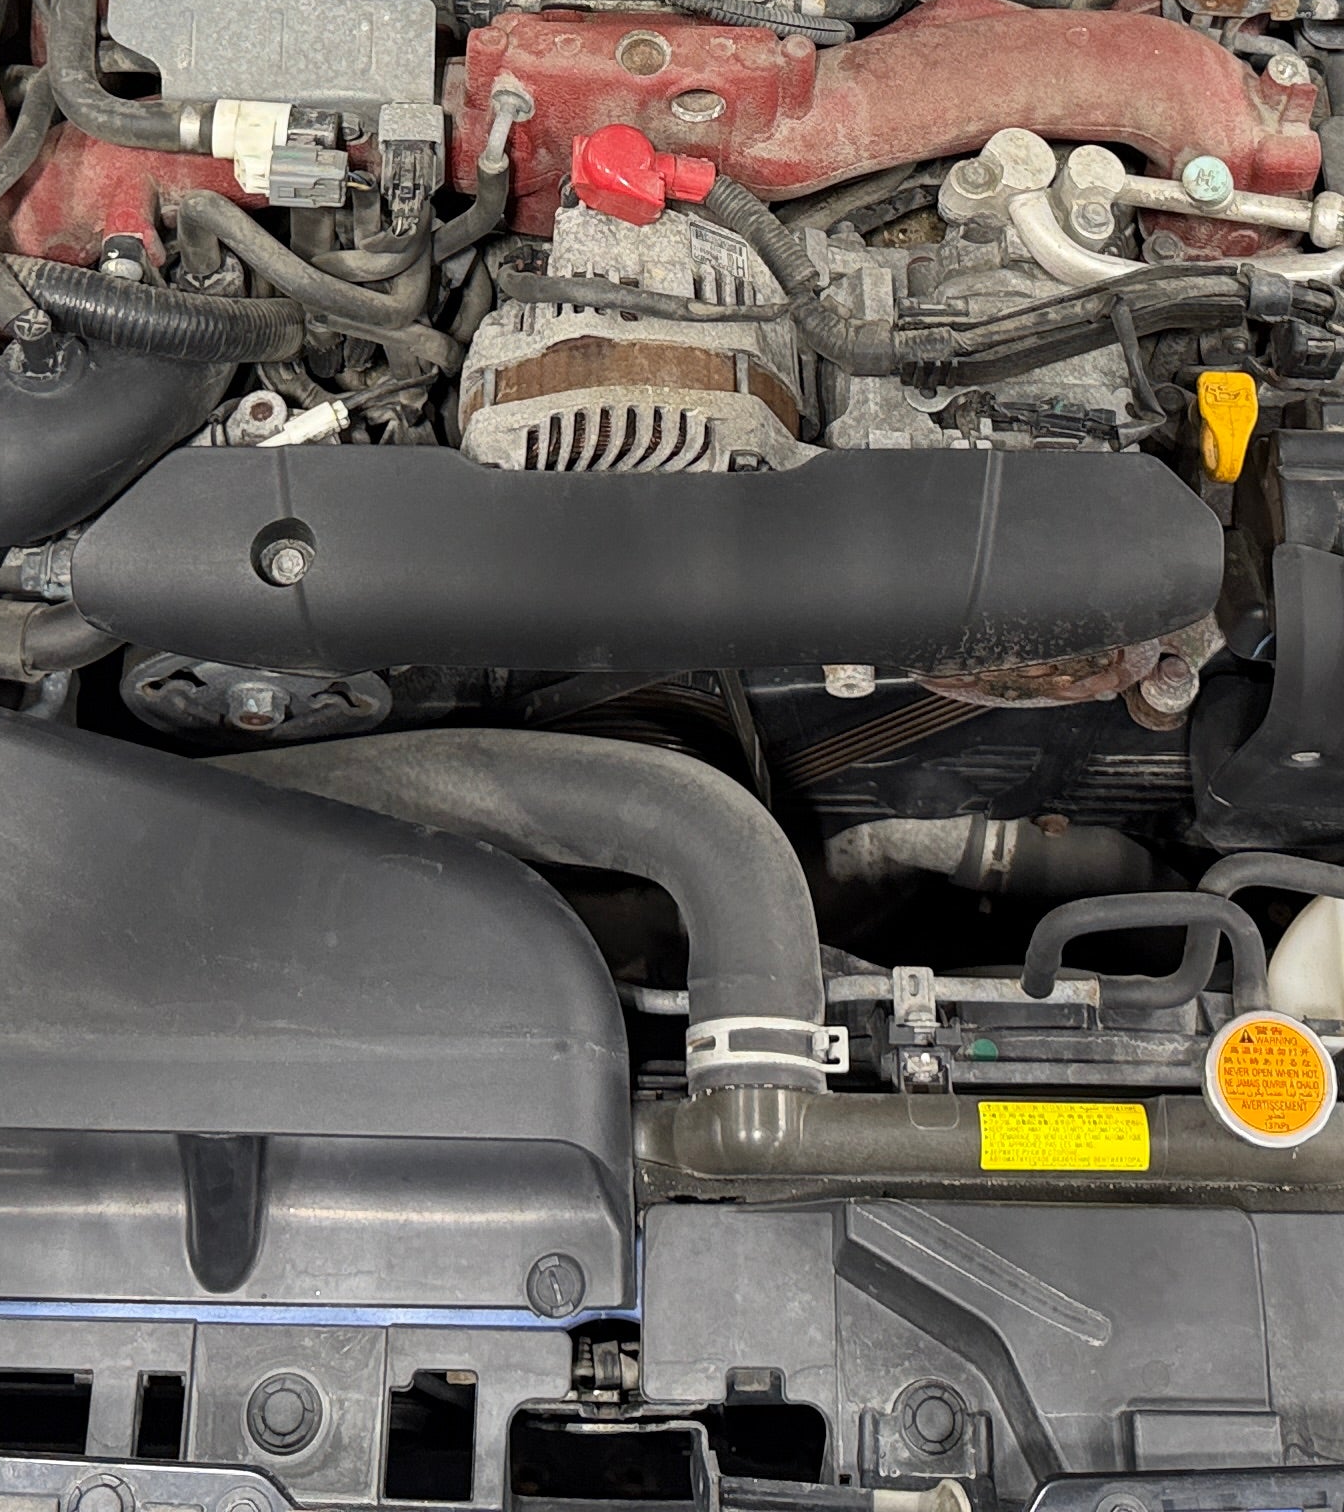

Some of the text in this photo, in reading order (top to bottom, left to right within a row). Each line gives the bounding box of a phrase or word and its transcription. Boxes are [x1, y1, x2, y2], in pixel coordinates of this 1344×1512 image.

[1256, 1037, 1298, 1046] WARNING
[1224, 1067, 1249, 1076] NEVER
[1252, 1068, 1272, 1077] OPEN
[1275, 1070, 1299, 1078] WHEN
[1241, 1100, 1307, 1111] AVERTISSEMENT
